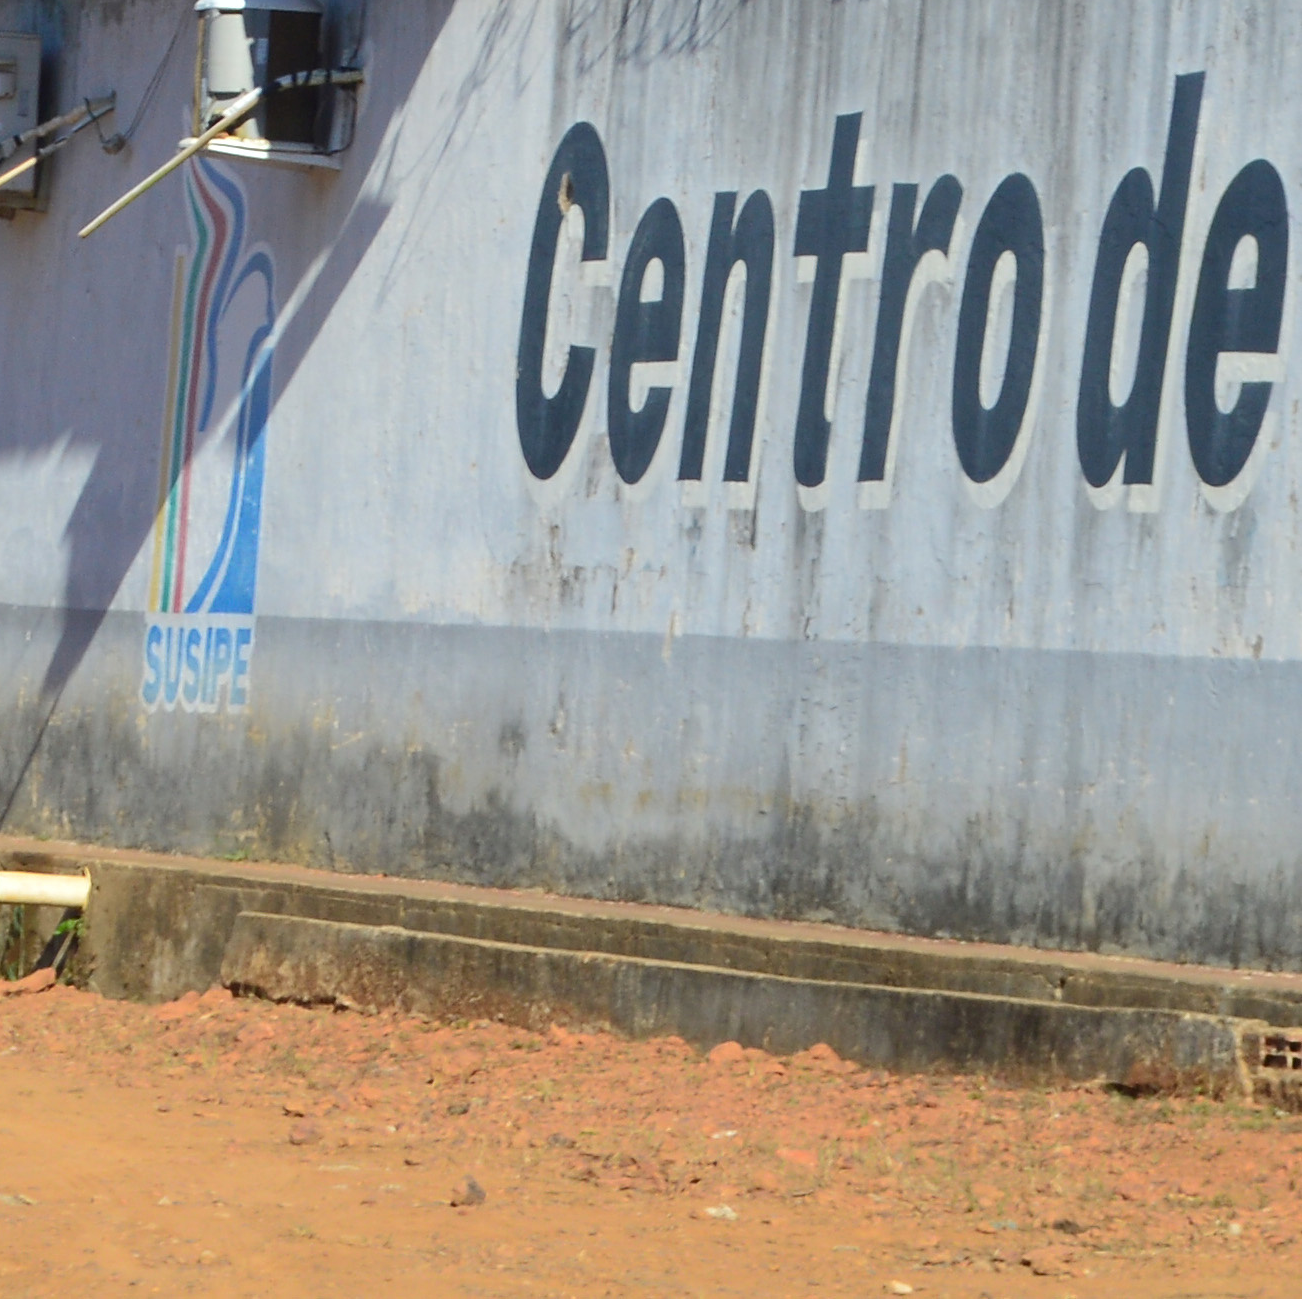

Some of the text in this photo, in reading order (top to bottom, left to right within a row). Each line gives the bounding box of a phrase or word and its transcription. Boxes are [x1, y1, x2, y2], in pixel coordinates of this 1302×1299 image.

[516, 70, 1290, 489] Centro de
[142, 625, 252, 705] SUSIPE
